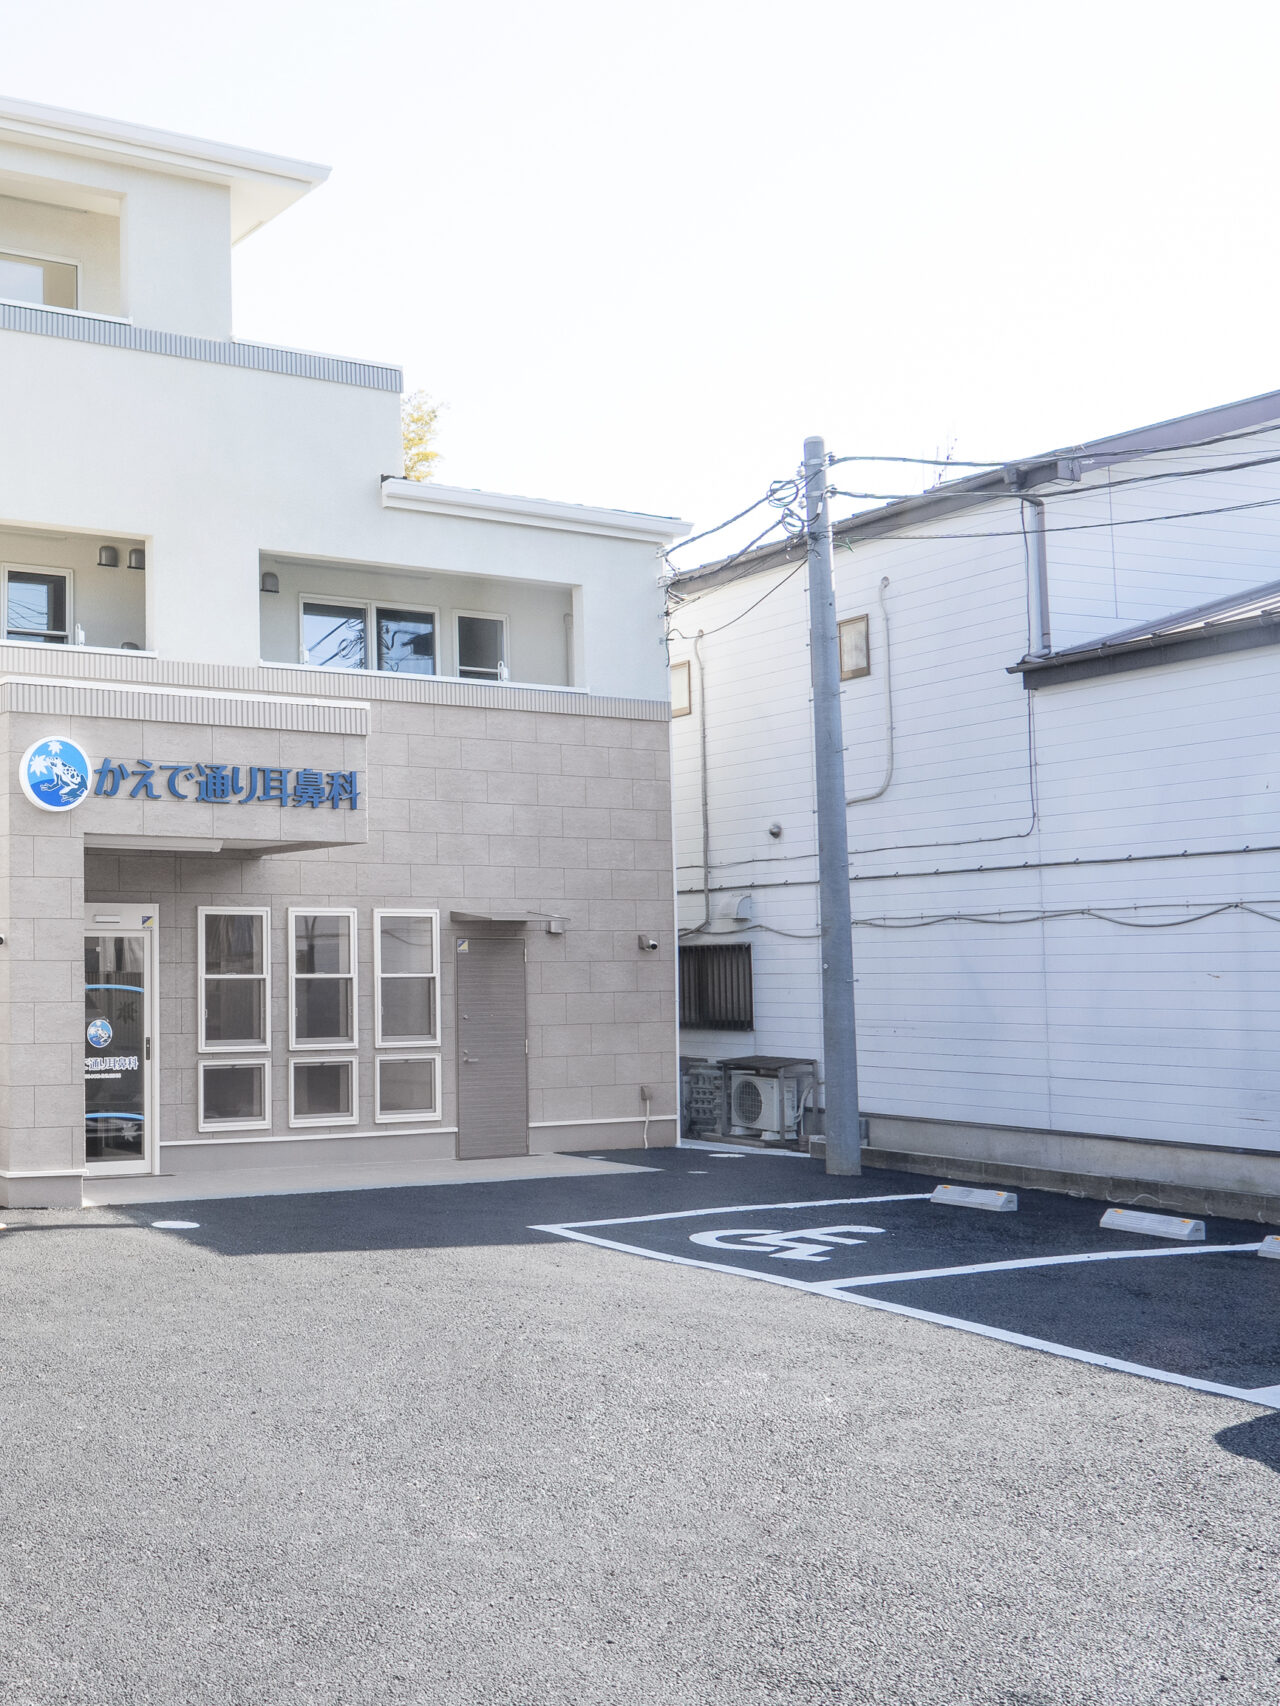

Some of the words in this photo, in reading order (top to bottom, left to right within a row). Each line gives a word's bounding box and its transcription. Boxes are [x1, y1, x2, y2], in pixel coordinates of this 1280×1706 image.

[94, 757, 361, 810] かえで通り耳鼻科
